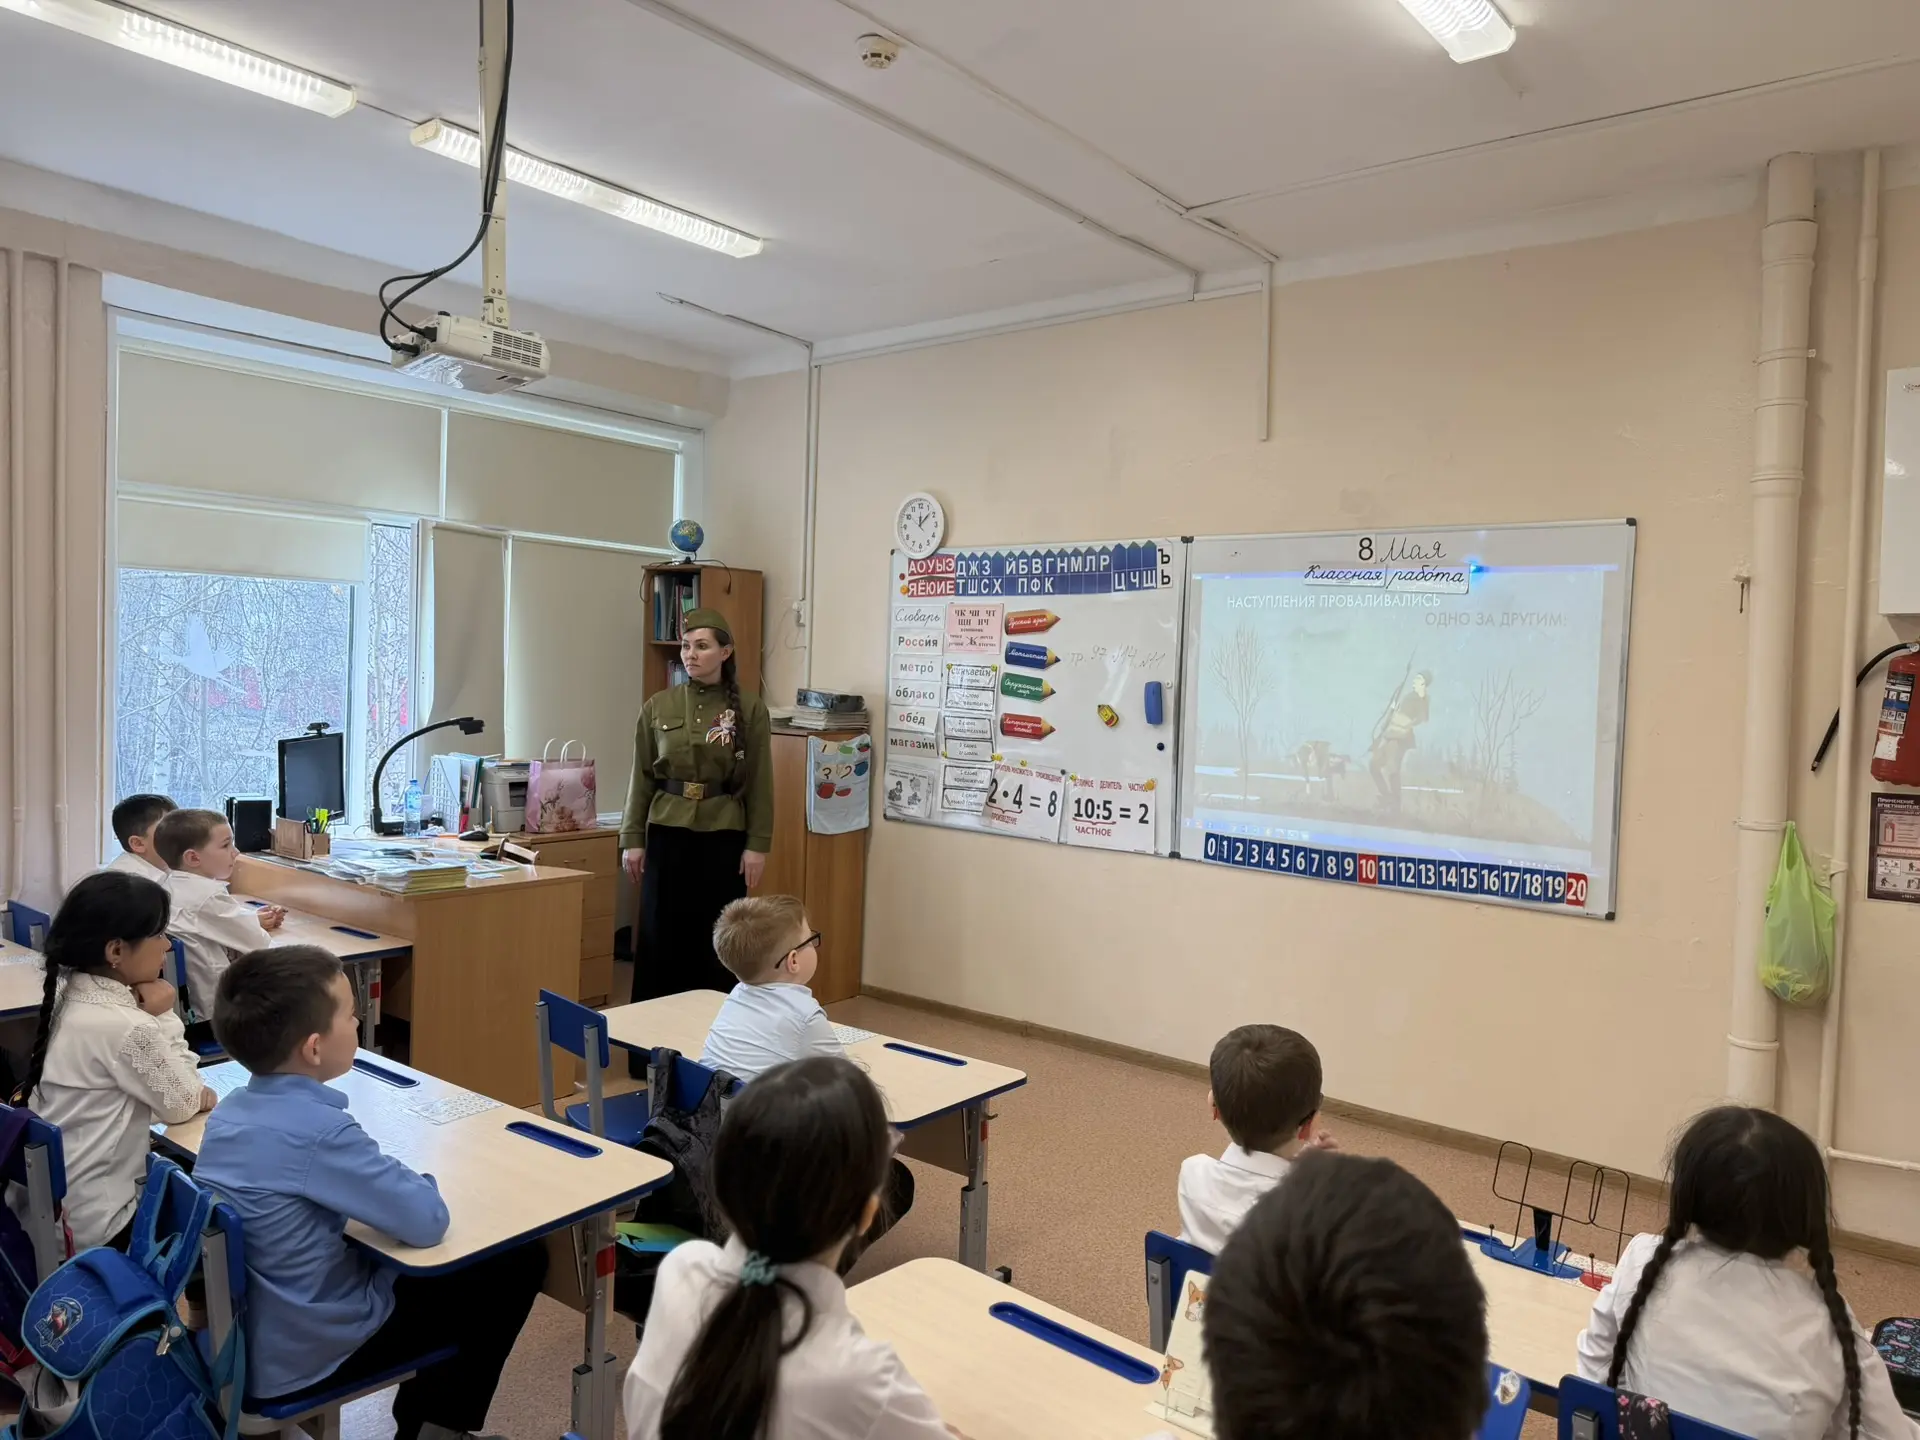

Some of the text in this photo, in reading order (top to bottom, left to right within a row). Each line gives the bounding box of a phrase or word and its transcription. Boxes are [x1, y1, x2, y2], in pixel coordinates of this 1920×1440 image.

[1358, 536, 1448, 562] 8 Мая
[1304, 564, 1383, 580] Классная
[1227, 594, 1441, 609] НАСТУПЛЕНИЯ ПРОВАЛИВАЛИСЬ
[896, 608, 940, 627] Словарь
[1425, 612, 1470, 628] ОДНО
[1475, 612, 1495, 626] ЗА
[1012, 784, 1023, 809] 4
[1048, 790, 1058, 817] 8
[1139, 803, 1149, 824] 2
[1075, 826, 1112, 836] ЧАСТНОЕ
[1207, 838, 1587, 901] 0 1 2 3 4 5 6 7 8 9 10 11 12 13 14 15 16 17 18 19 20
